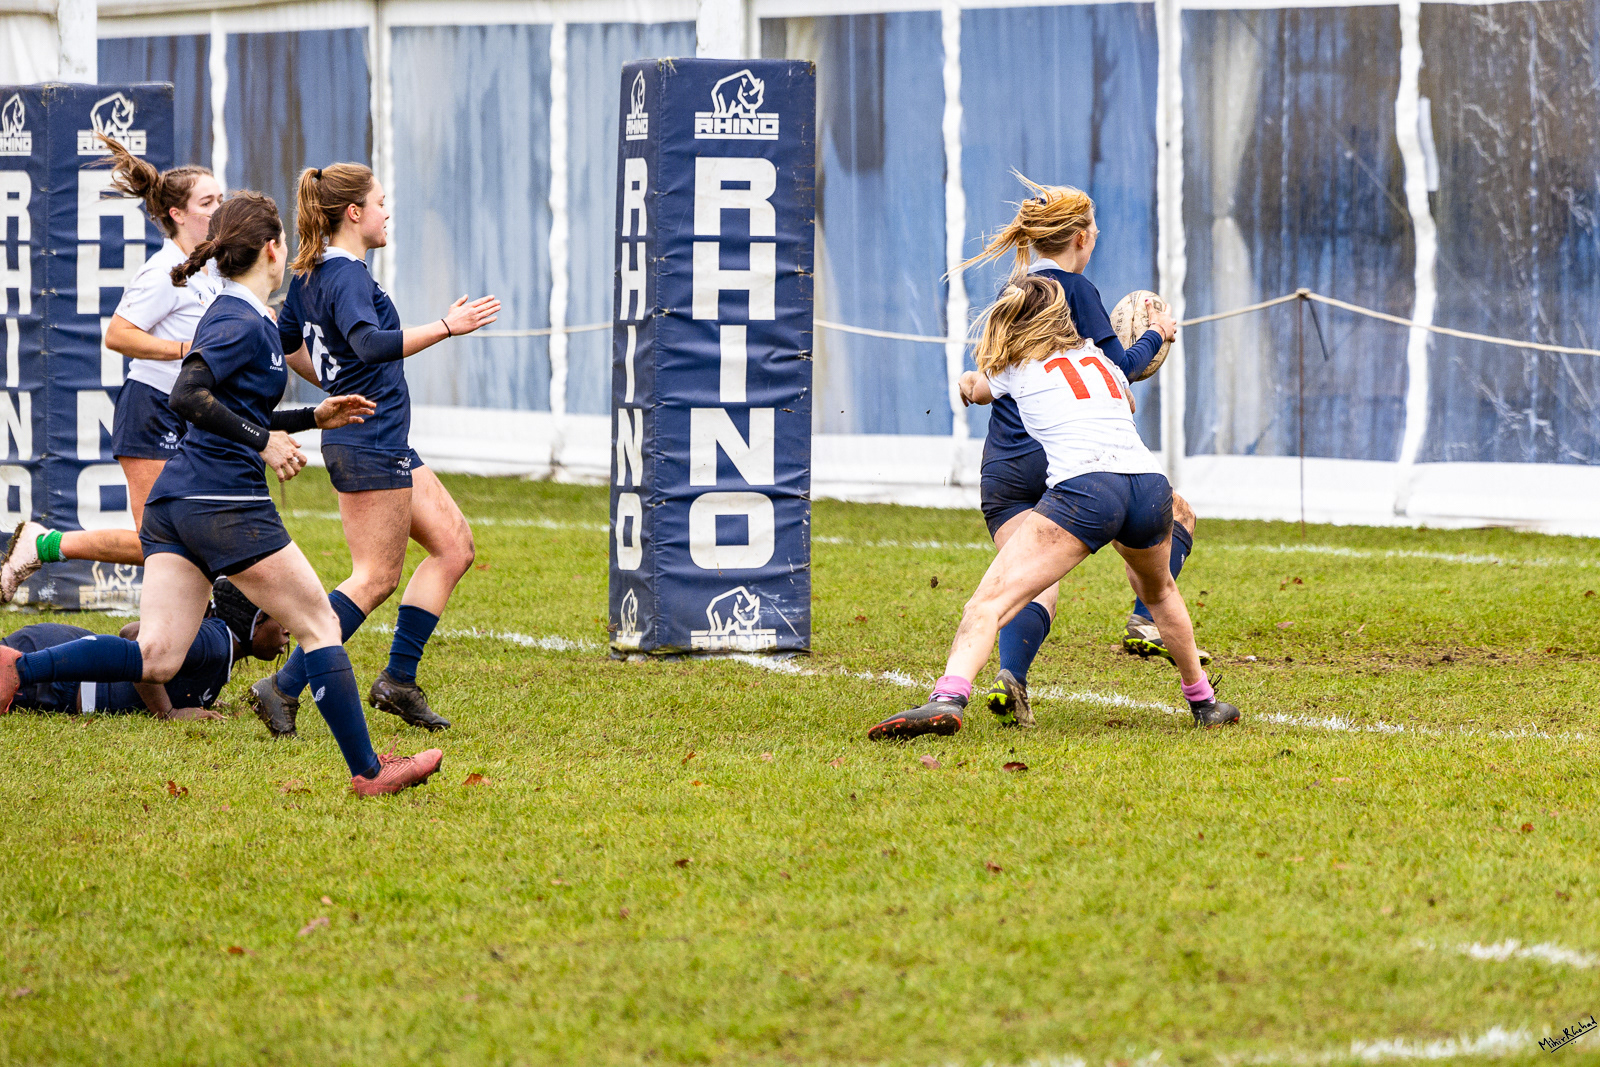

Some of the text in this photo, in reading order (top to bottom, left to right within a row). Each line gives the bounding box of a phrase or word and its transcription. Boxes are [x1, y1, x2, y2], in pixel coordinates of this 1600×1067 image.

[626, 118, 648, 135] RHINO
[694, 118, 779, 135] RHINO
[0, 136, 32, 151] HINO
[615, 157, 648, 571] RHINO
[689, 157, 778, 570] RHINO
[1044, 356, 1122, 400] 11
